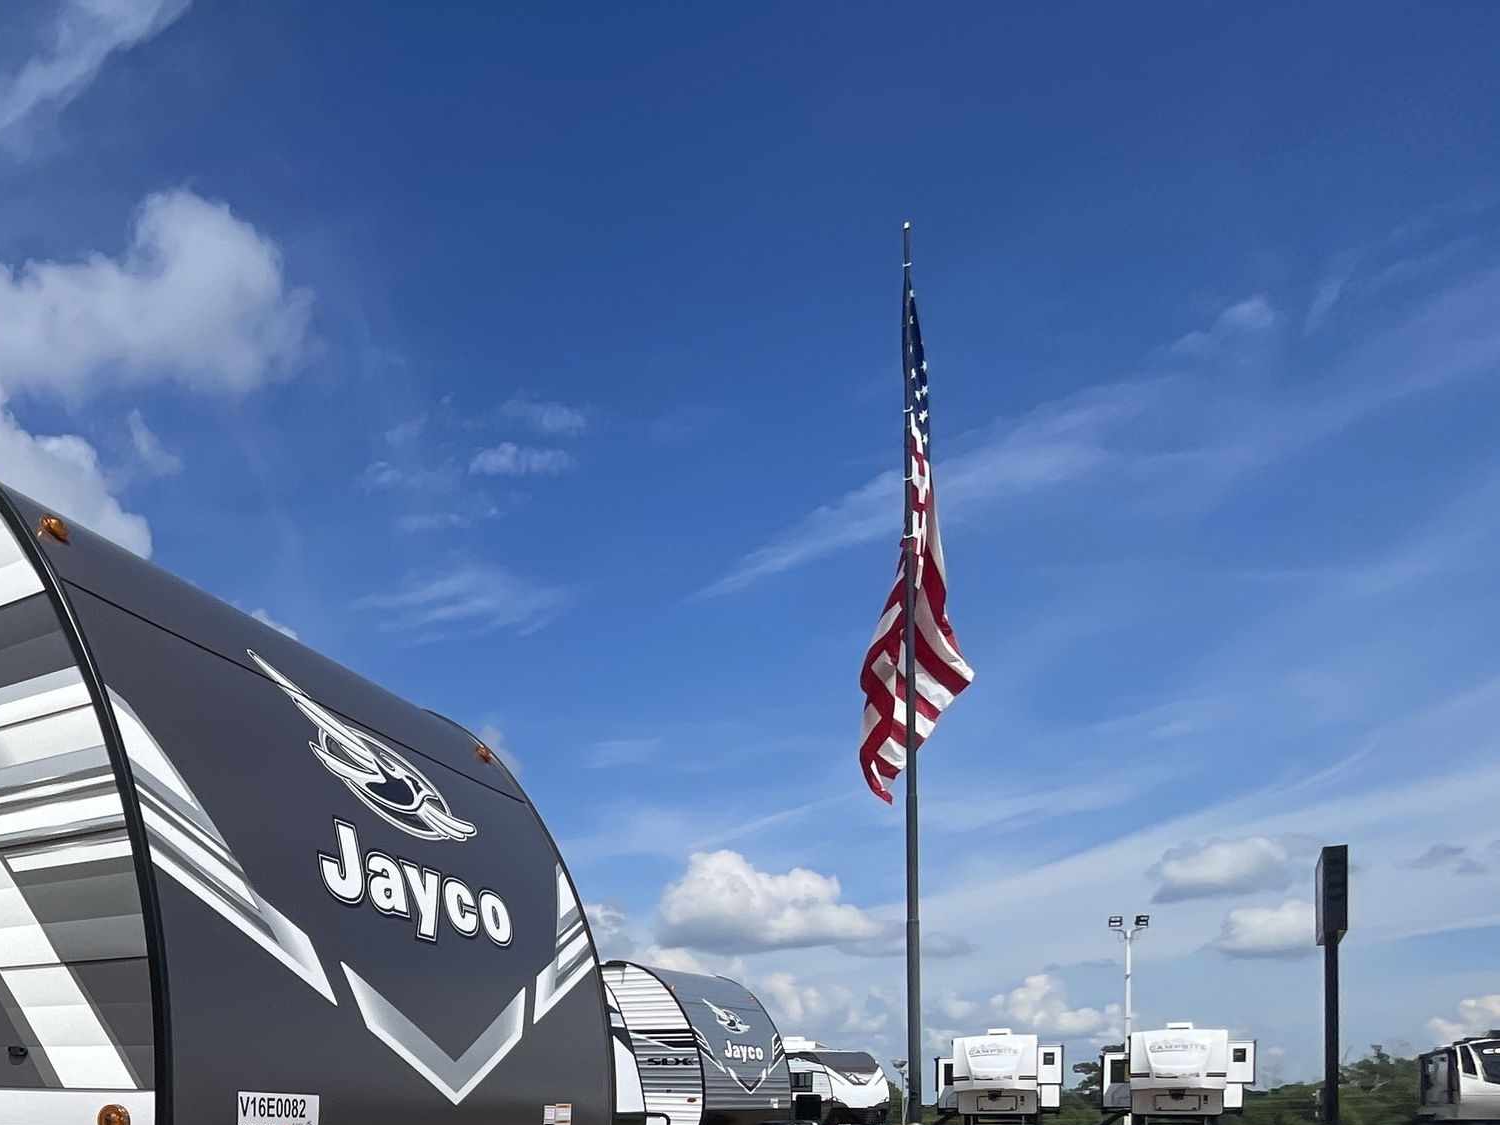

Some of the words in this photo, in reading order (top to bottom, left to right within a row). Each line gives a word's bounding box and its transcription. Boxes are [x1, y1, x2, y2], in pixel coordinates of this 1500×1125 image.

[318, 817, 514, 947] Jayco
[724, 1040, 764, 1063] Jayco
[240, 1096, 306, 1118] V16E0082
